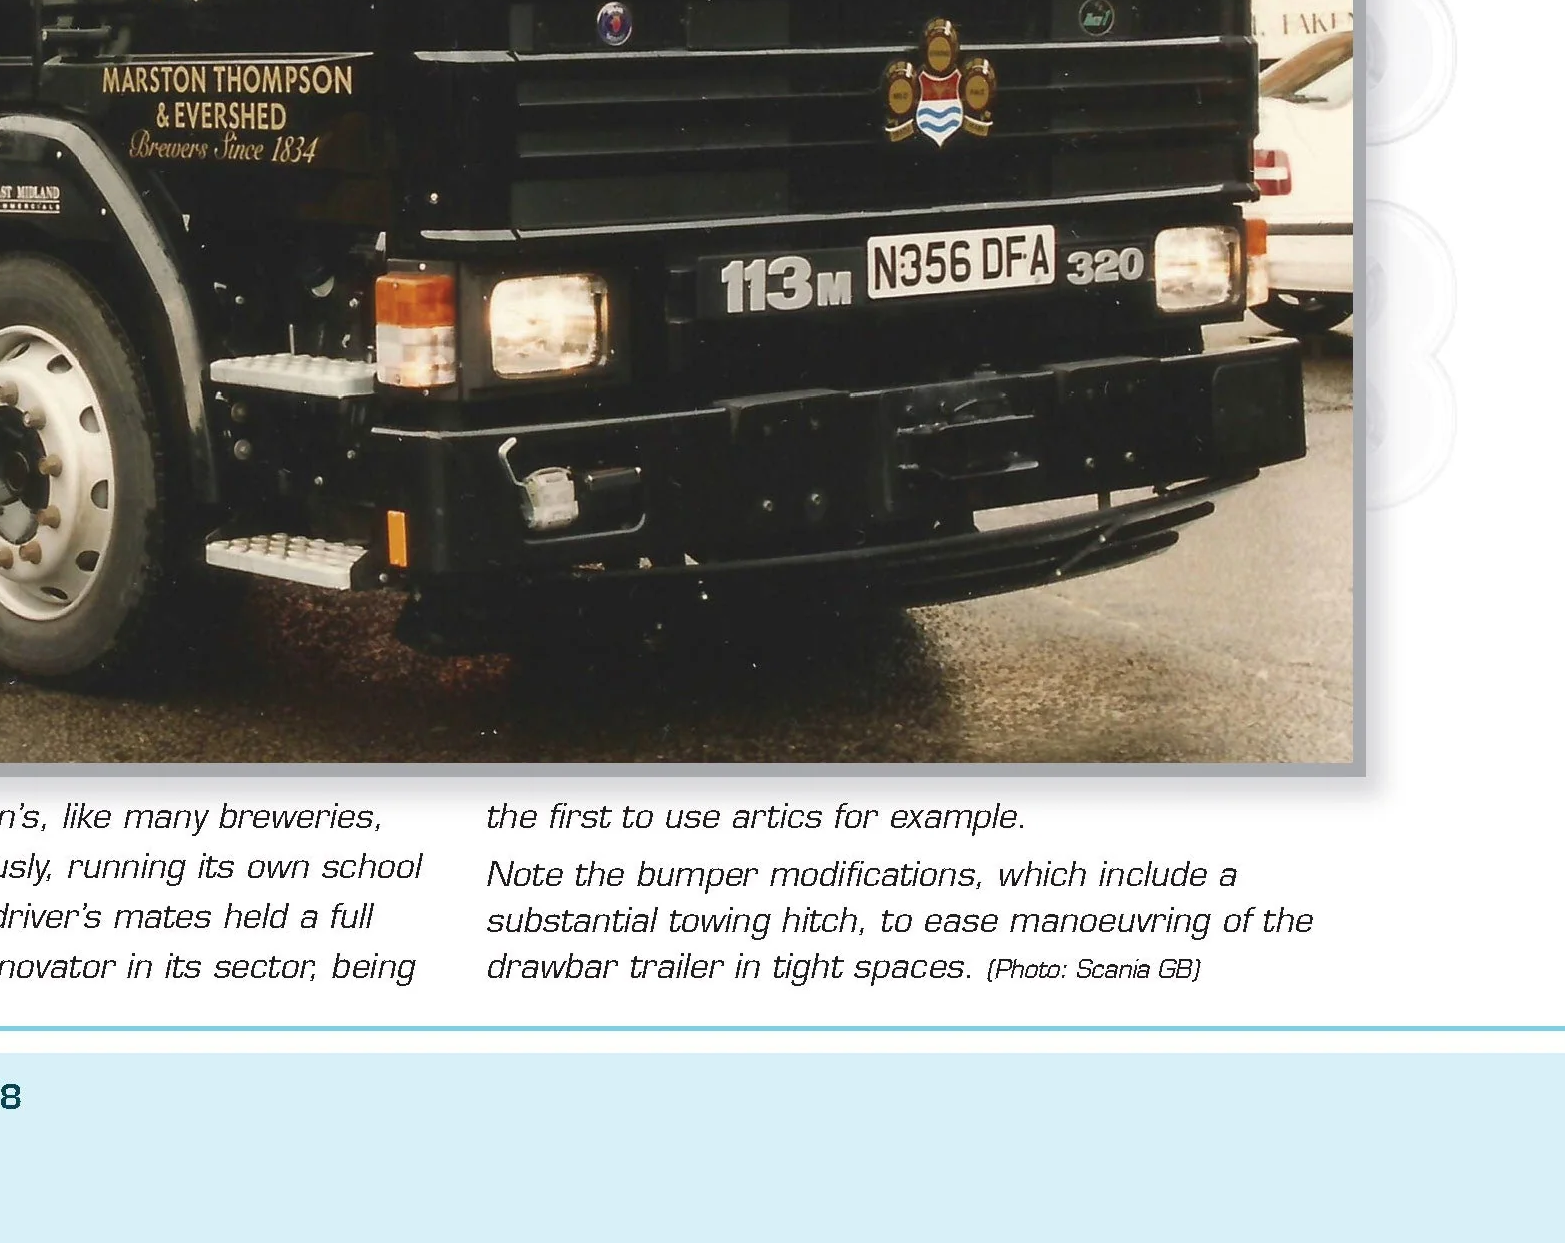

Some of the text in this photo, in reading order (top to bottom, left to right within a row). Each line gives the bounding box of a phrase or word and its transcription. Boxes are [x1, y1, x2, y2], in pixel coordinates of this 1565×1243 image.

[102, 65, 353, 95] MARSTON THOMPSON
[156, 102, 286, 130] & EVERSHED
[129, 129, 320, 163] Brewers Since 1834
[17, 185, 60, 199] MIDLAND
[874, 233, 1049, 290] N356 DFA
[1067, 247, 1144, 285] 320
